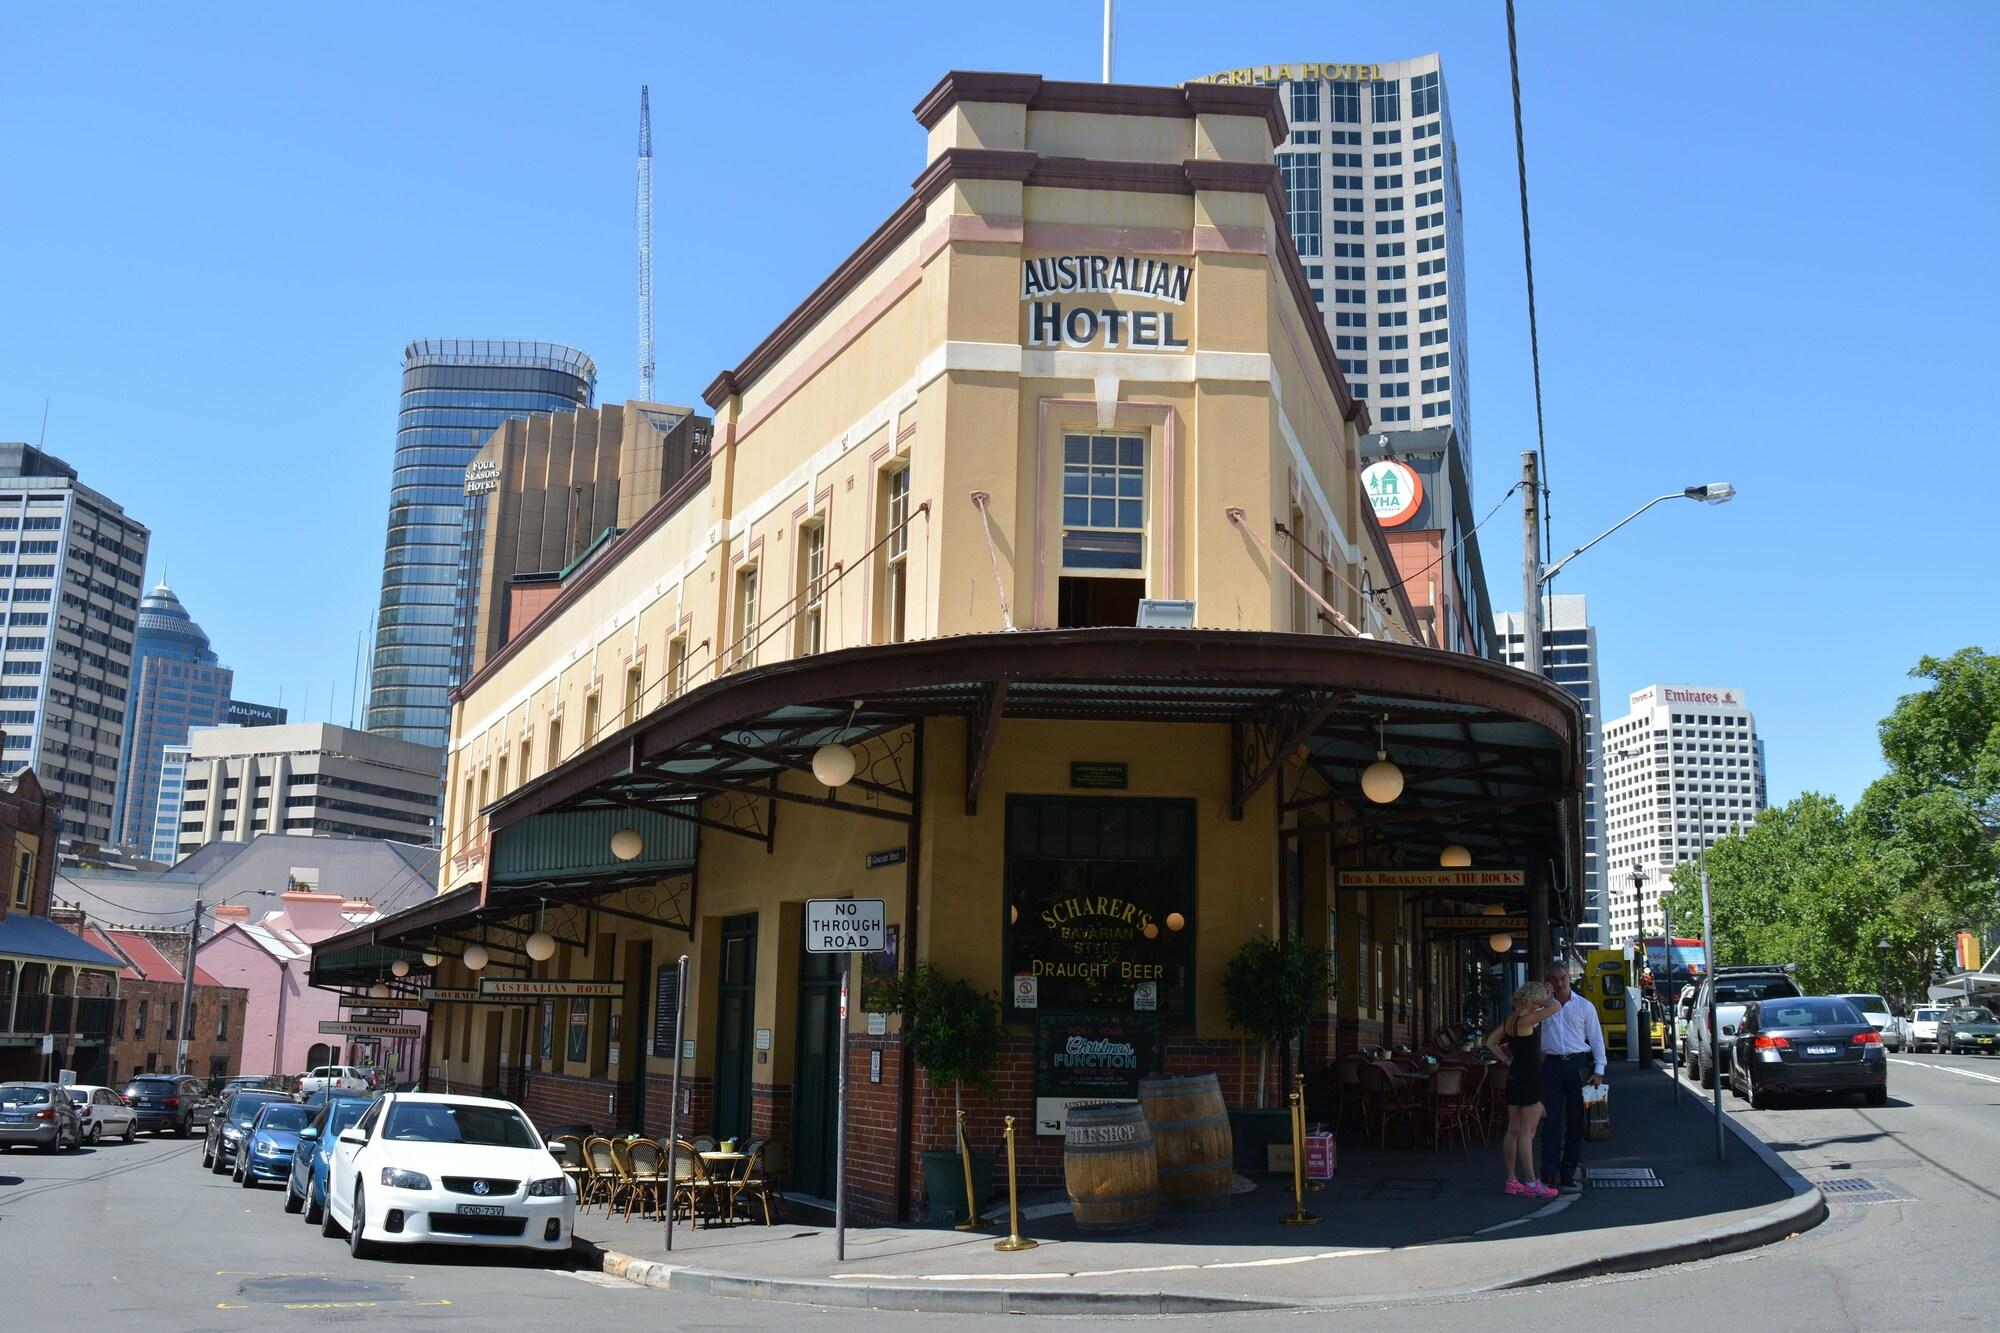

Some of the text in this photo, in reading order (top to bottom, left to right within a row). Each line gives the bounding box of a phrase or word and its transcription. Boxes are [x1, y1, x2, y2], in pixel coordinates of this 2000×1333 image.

[1301, 62, 1385, 81] HOTEL
[1022, 256, 1193, 304] AUSTRALIAN
[1030, 302, 1188, 351] HOTEL
[473, 461, 495, 471] FOUR
[465, 470, 500, 481] SEASONS
[467, 481, 496, 492] HOTEL
[1371, 496, 1400, 507] YHA
[1664, 688, 1718, 703] Emirates
[228, 705, 272, 719] MULPHA
[1364, 874, 1374, 883] &
[1378, 873, 1433, 884] BREAKFAST
[1453, 872, 1477, 883] THE
[1481, 872, 1520, 883] ROCKS
[835, 903, 857, 915] NO
[1041, 896, 1152, 931] SCHARER'S
[813, 919, 880, 931] THROUGH
[1061, 927, 1134, 940] BAVARIAN
[823, 936, 869, 947] ROAD
[1032, 959, 1163, 979] DRAUGHT BEER
[434, 991, 476, 999] GOURME
[495, 983, 614, 994] AUSTRALIAN HOTEL
[1066, 1035, 1134, 1056] Christmas
[1054, 1053, 1137, 1068] FUNCTION
[1099, 1124, 1136, 1143] SHOP
